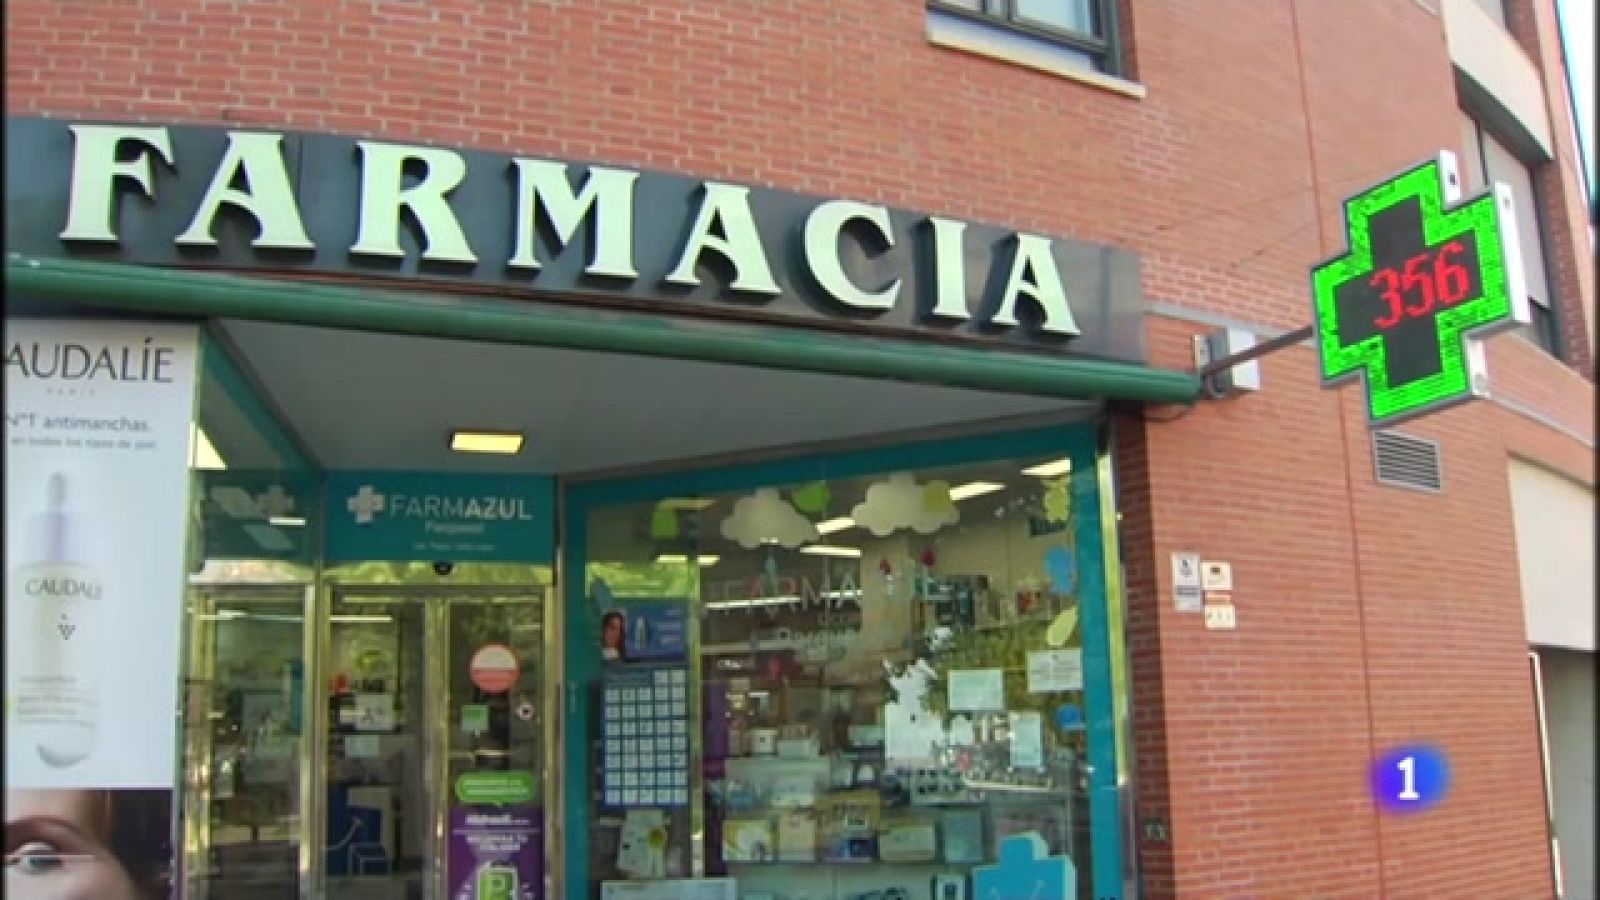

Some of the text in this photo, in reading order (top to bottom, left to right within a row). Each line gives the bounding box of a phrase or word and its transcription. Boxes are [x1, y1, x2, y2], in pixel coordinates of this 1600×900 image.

[58, 124, 1081, 336] FARMACIA
[1370, 241, 1471, 329] 356
[389, 494, 534, 521] FARMAZUL
